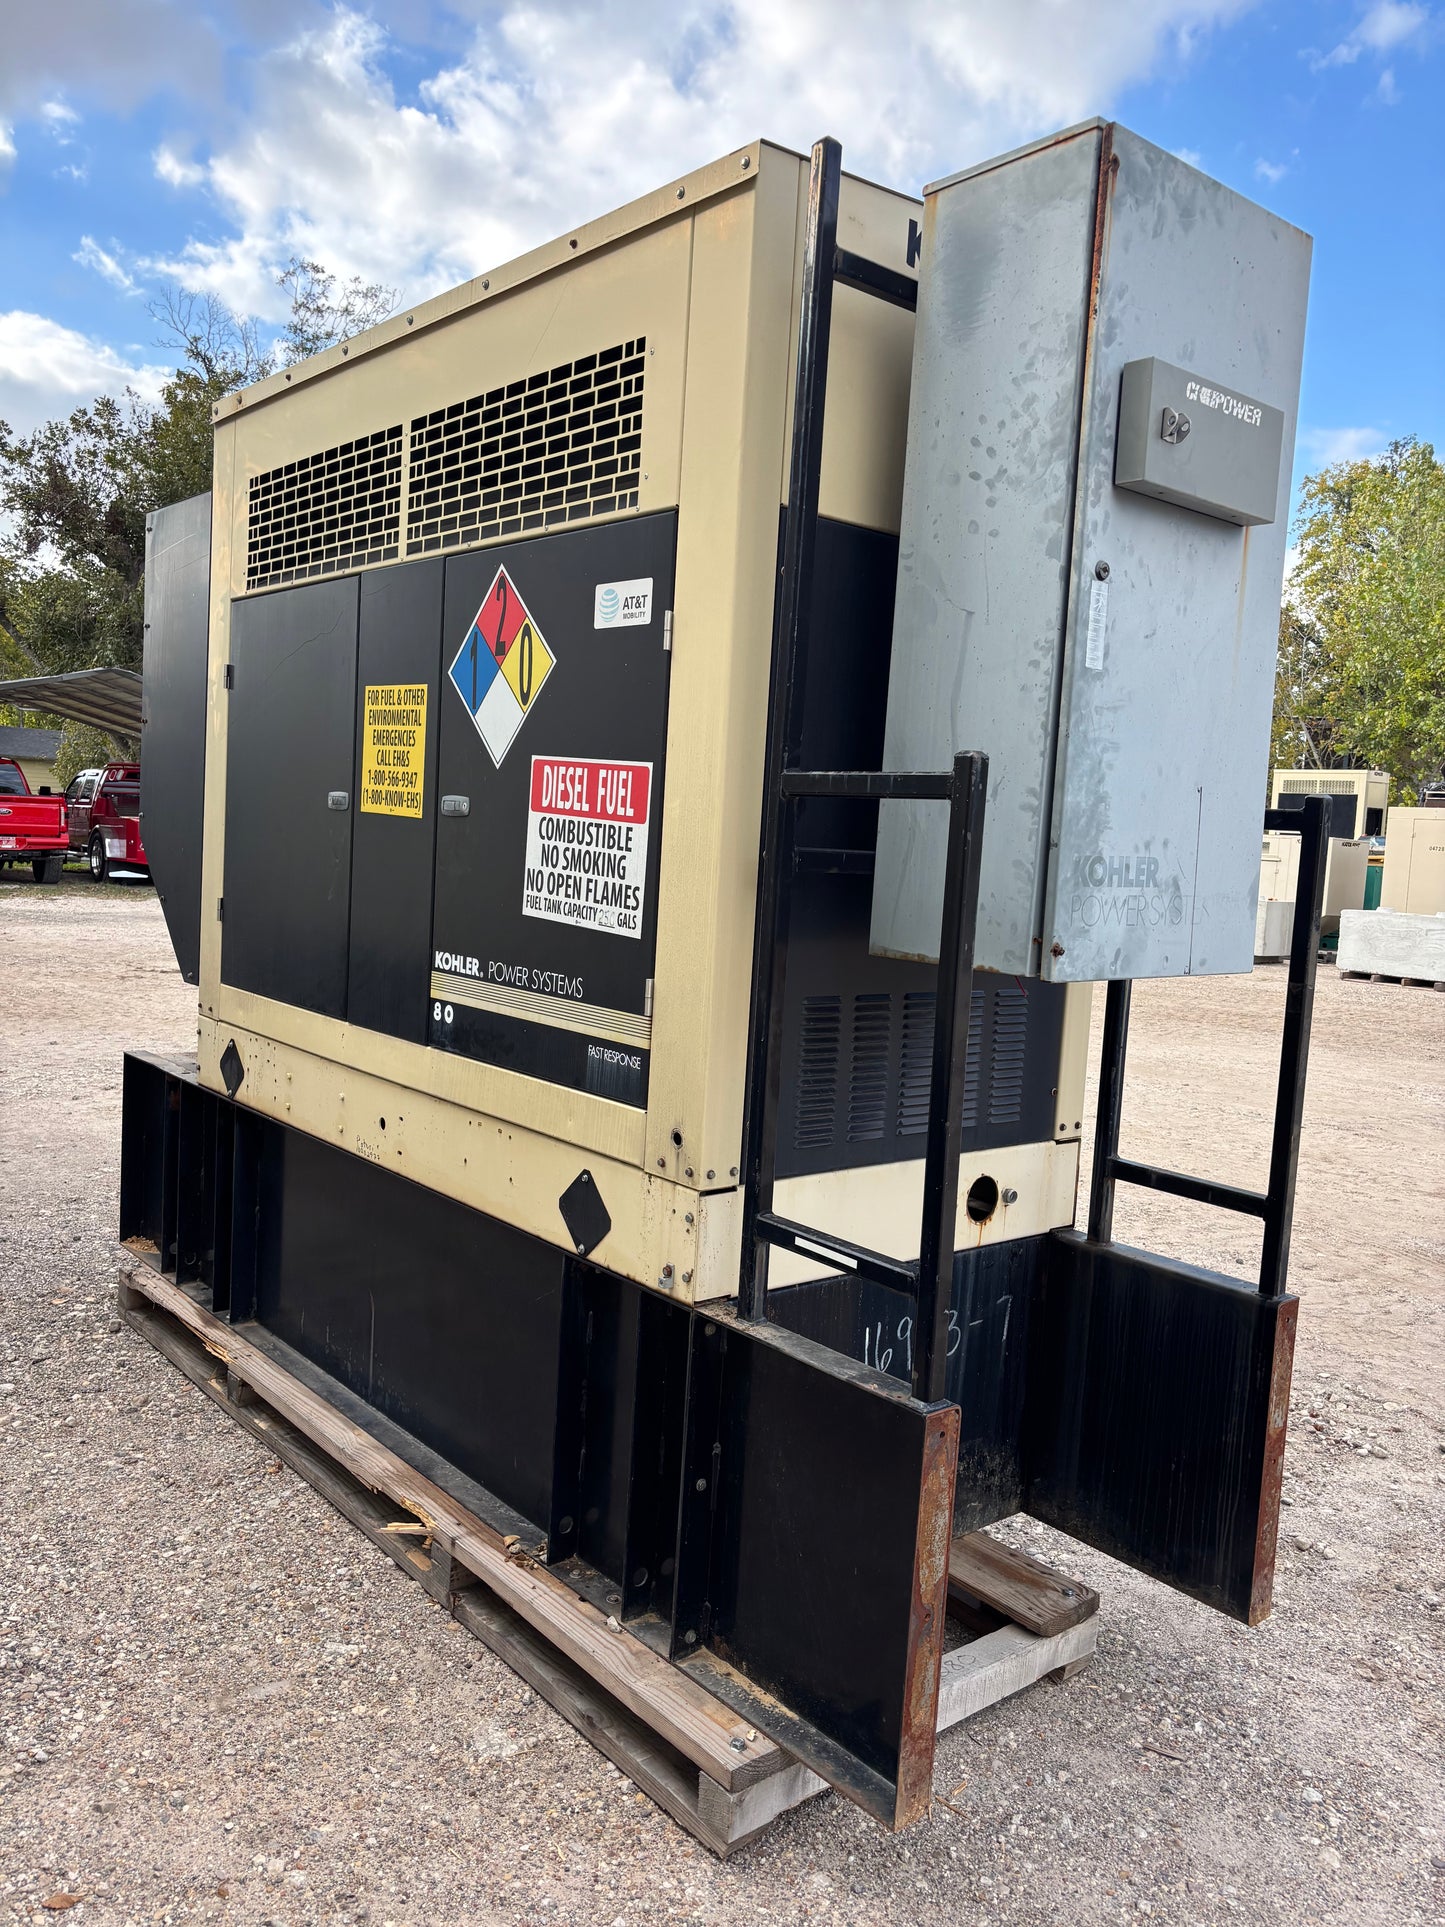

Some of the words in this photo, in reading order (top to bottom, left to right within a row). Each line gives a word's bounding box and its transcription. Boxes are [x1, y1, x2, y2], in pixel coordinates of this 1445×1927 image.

[494, 576, 507, 657] 2
[622, 595, 649, 611] AT&T
[622, 611, 646, 620] MOBILITY
[470, 631, 478, 710] 1
[519, 623, 533, 707] 0
[367, 690, 380, 706] FOR
[380, 689, 396, 706] FUEL
[397, 689, 402, 706] &
[403, 688, 425, 706] OTHER
[368, 709, 422, 726] ENVIRONMENTAL
[372, 729, 416, 747] EMERGENCIES
[376, 749, 391, 767] CALL
[392, 750, 410, 768] EH&S
[367, 769, 418, 789] 1-800-566-9347
[541, 765, 590, 812] DIESEL
[597, 769, 634, 817] FUEL
[362, 788, 421, 812] (1-800-KNOW-EHS)
[538, 816, 634, 852] COMBUSTIBLE
[541, 843, 560, 869] NO
[561, 846, 627, 880] SMOKING
[1073, 855, 1160, 888] KOHLER
[526, 867, 544, 893] NO
[546, 871, 582, 900] OPEN
[585, 877, 640, 911] FLAMES
[525, 894, 542, 911] FUEL
[543, 897, 562, 915] TANK
[563, 901, 599, 922] CAPACITY
[616, 912, 637, 930] GALS
[1070, 895, 1147, 927] POWER
[434, 950, 480, 977] KOHLER
[488, 960, 529, 987] POWER
[531, 968, 584, 998] SYSTEMS
[433, 1001, 454, 1024] 80
[587, 1044, 604, 1059] FAST
[603, 1048, 642, 1070] RESPONSE
